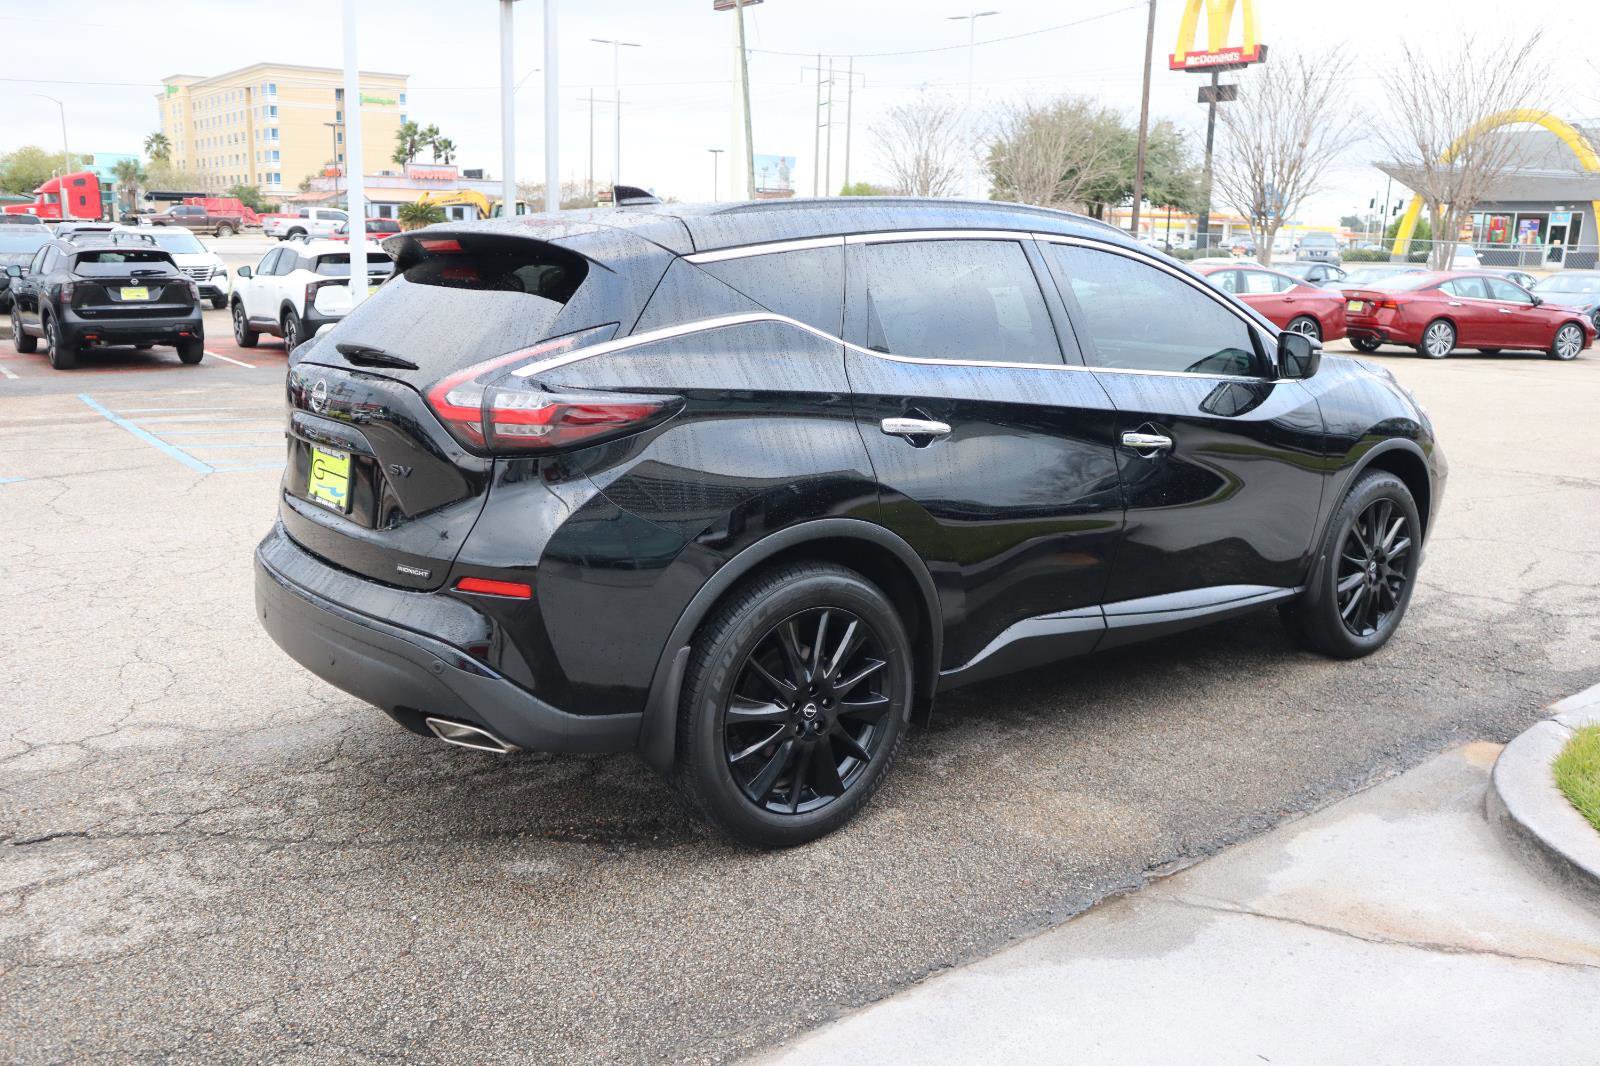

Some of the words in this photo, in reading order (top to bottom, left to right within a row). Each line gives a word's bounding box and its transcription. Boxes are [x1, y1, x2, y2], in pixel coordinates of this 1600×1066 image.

[1185, 52, 1240, 65] McDonald's
[389, 464, 413, 479] SV
[396, 565, 430, 578] MIDNIGHT
